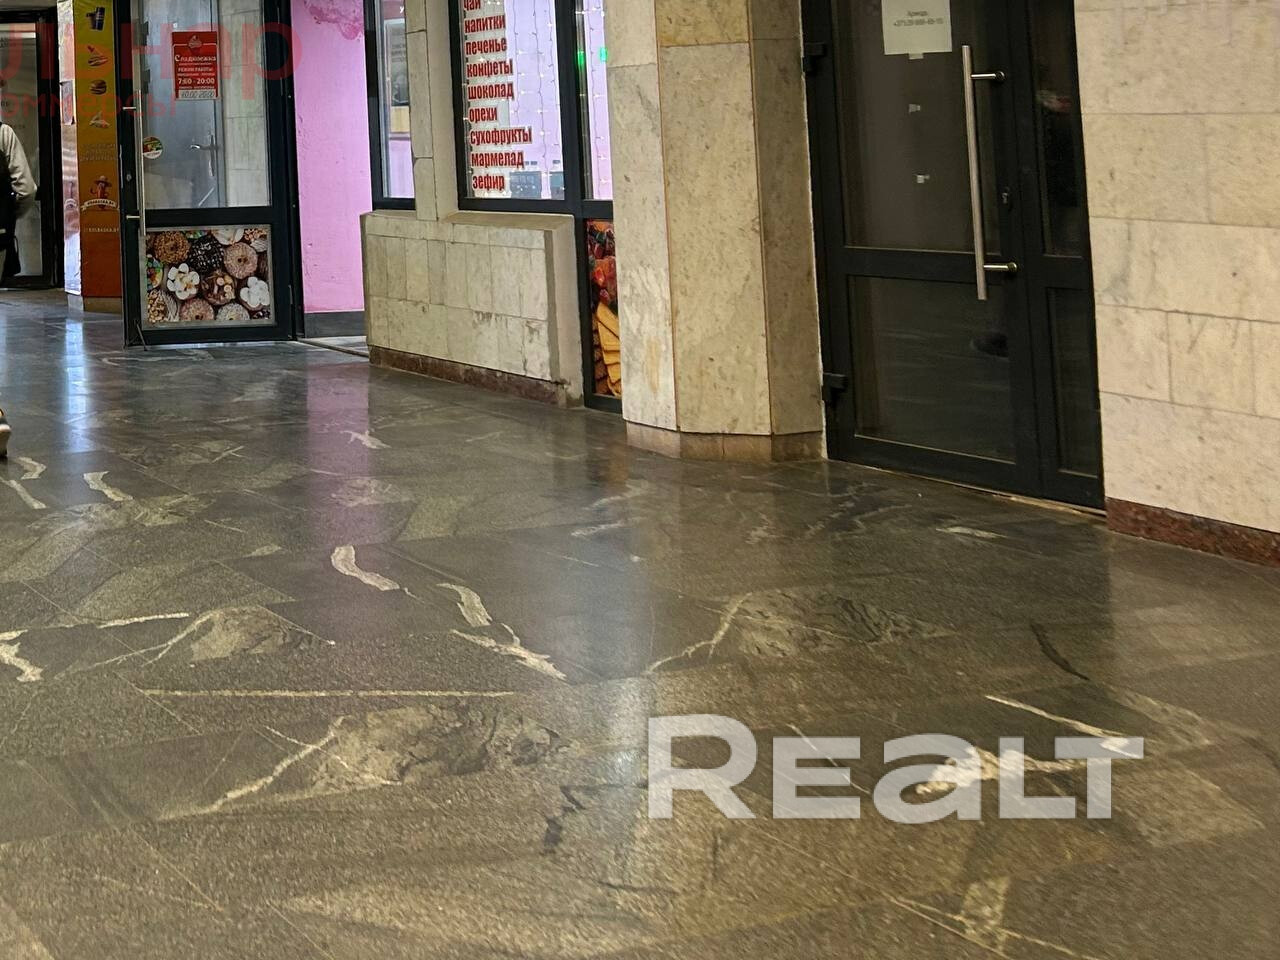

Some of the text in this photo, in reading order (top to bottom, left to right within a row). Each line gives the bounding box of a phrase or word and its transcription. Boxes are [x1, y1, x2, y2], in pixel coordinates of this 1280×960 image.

[465, 15, 506, 33] напитки
[465, 37, 507, 55] печенье
[466, 59, 513, 78] конфеты
[468, 82, 514, 100] шоколад
[469, 107, 497, 122] орехи
[470, 126, 532, 145] сухофрукты
[471, 151, 524, 168] мармелад
[472, 174, 505, 190] зефир
